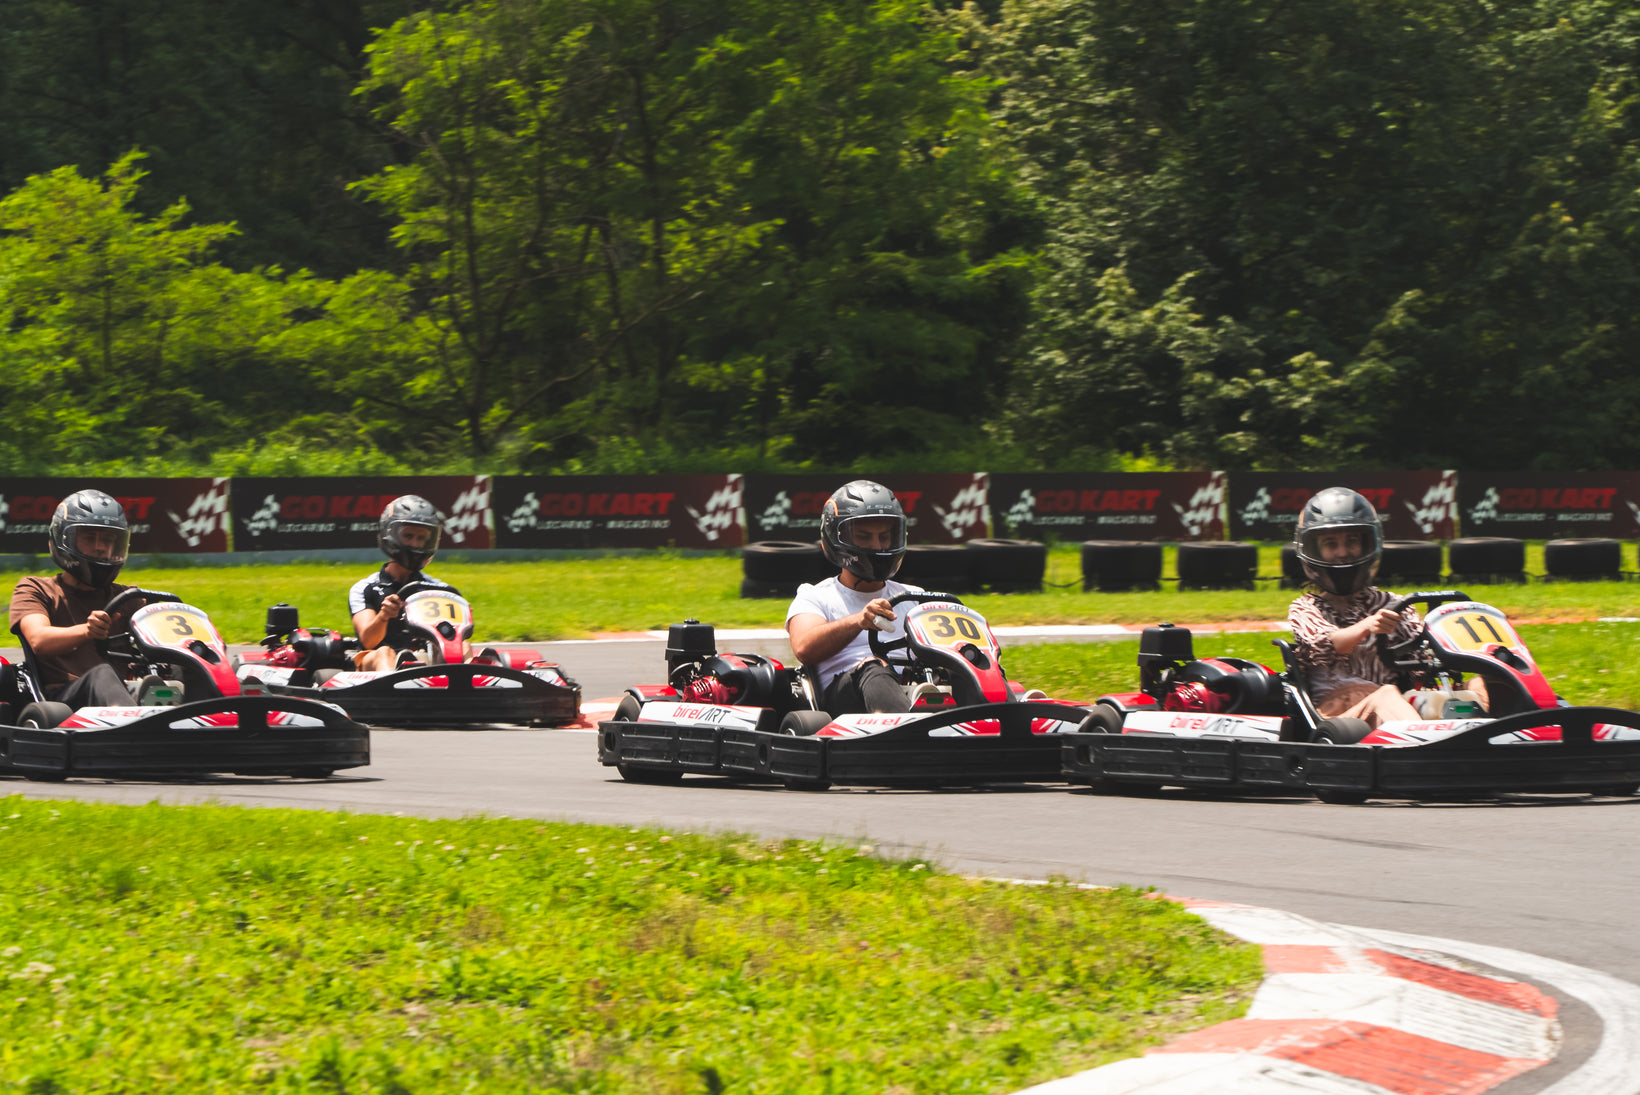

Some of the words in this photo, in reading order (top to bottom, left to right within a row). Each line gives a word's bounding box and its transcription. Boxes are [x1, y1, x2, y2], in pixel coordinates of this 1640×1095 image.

[281, 496, 325, 519] GO
[540, 493, 584, 516] GO
[586, 492, 675, 516] KART
[1035, 490, 1076, 512] GO
[1079, 489, 1161, 511] KART
[1499, 488, 1537, 510] GO
[1540, 487, 1617, 509] KART
[423, 601, 456, 619] 31
[166, 615, 193, 636] 3
[928, 614, 981, 640] 30
[1455, 615, 1504, 643] 11
[672, 704, 732, 724] birelART
